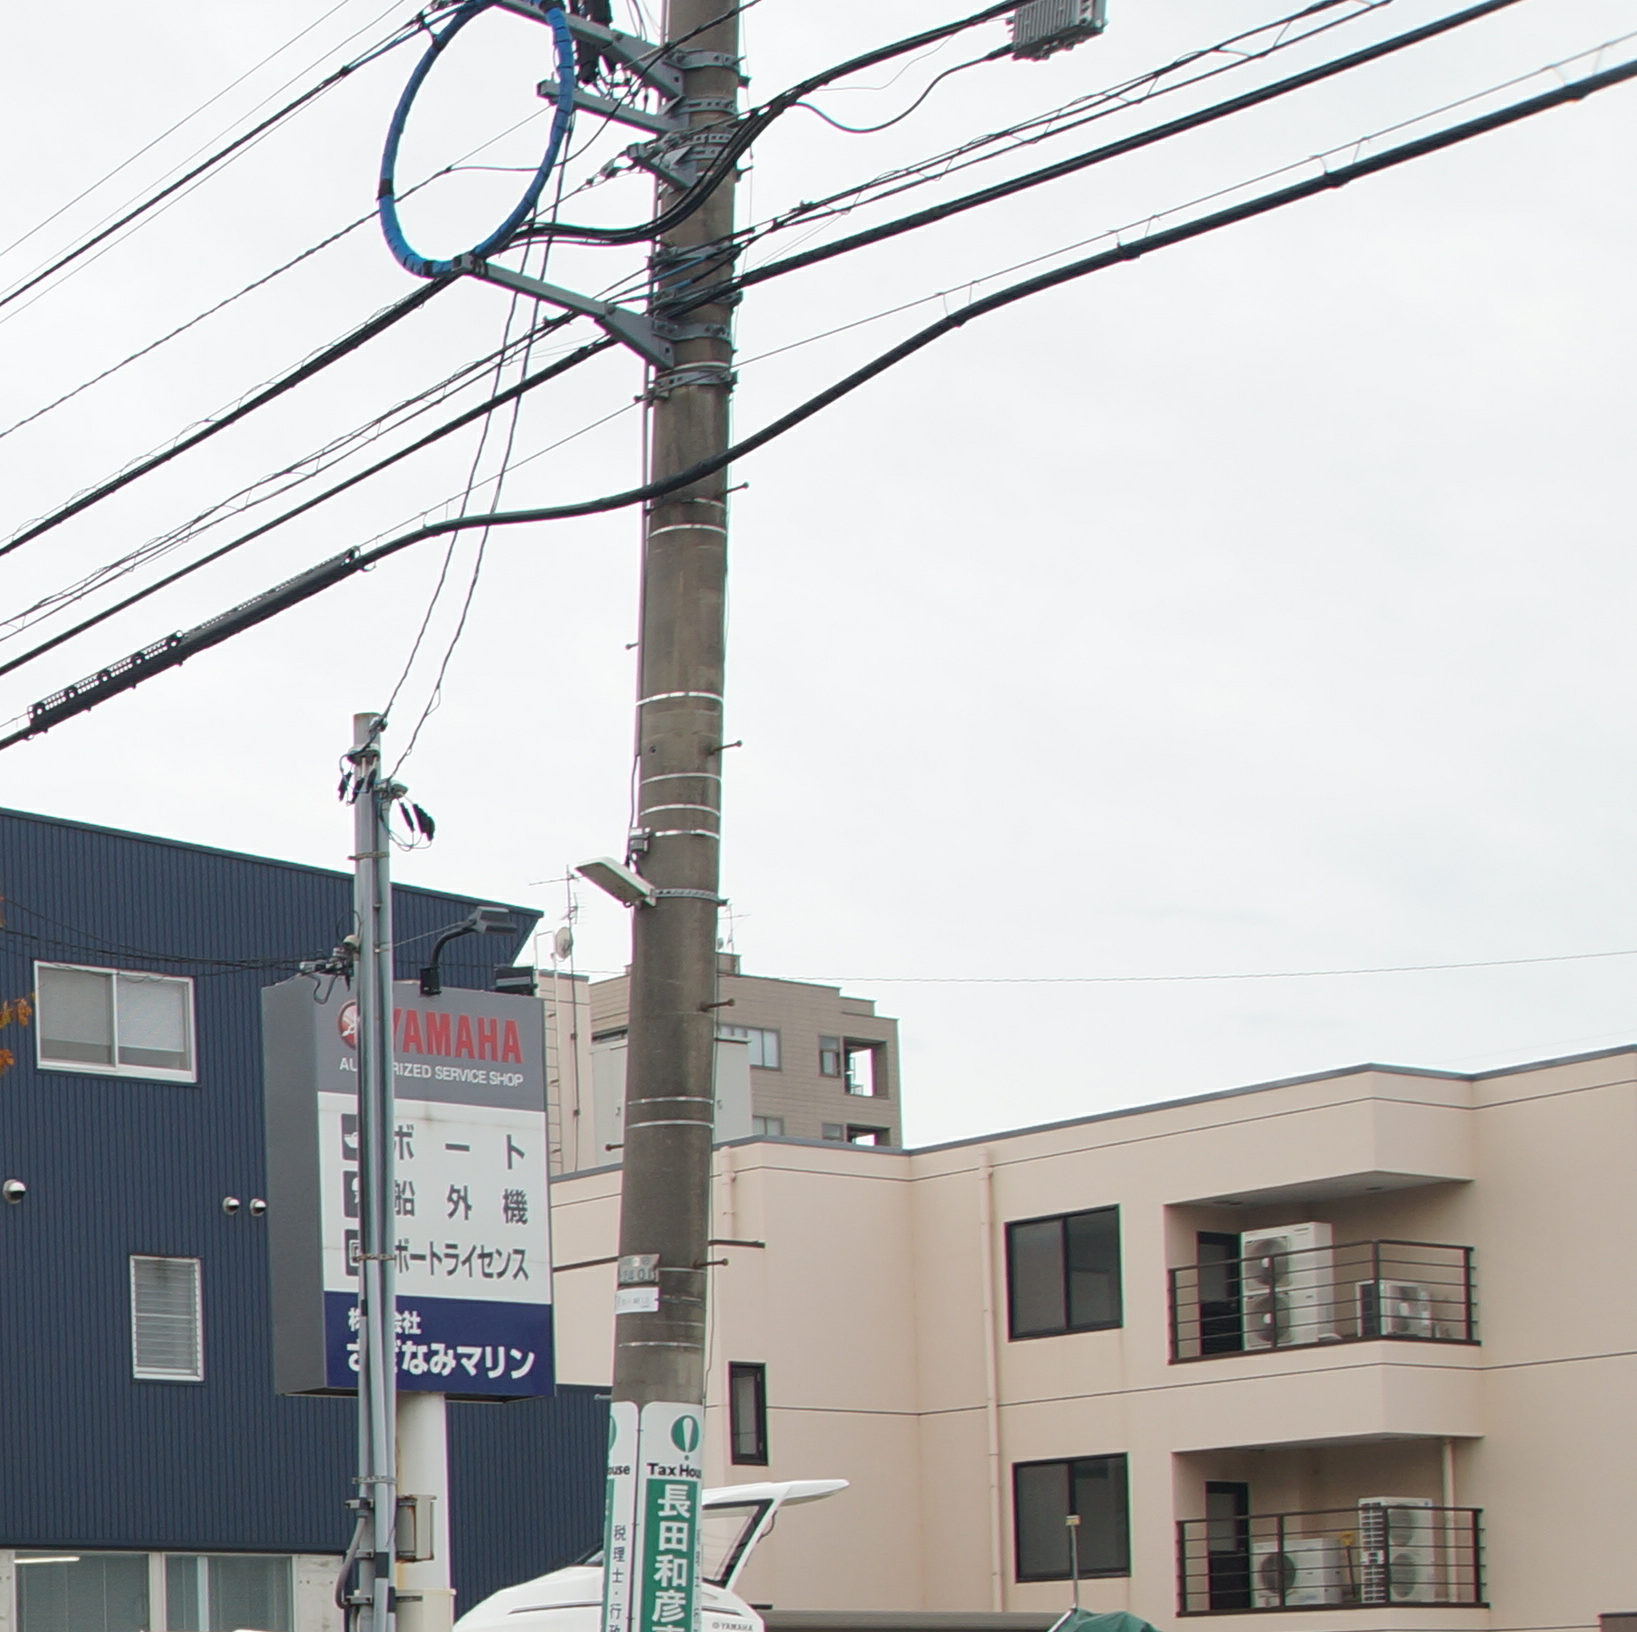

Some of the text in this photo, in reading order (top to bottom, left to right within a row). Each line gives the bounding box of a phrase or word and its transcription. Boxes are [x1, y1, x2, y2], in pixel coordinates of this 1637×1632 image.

[339, 1056, 524, 1087] AURIZED SERVICE SHOP
[393, 1123, 526, 1170] ボート
[394, 1179, 529, 1225] 船外機
[394, 1238, 529, 1281] ボートライセンス
[348, 1306, 422, 1335] 株社
[346, 1340, 535, 1380] さなみマリン
[647, 1463, 677, 1477] Tax
[721, 1621, 754, 1632] YAMAHA
